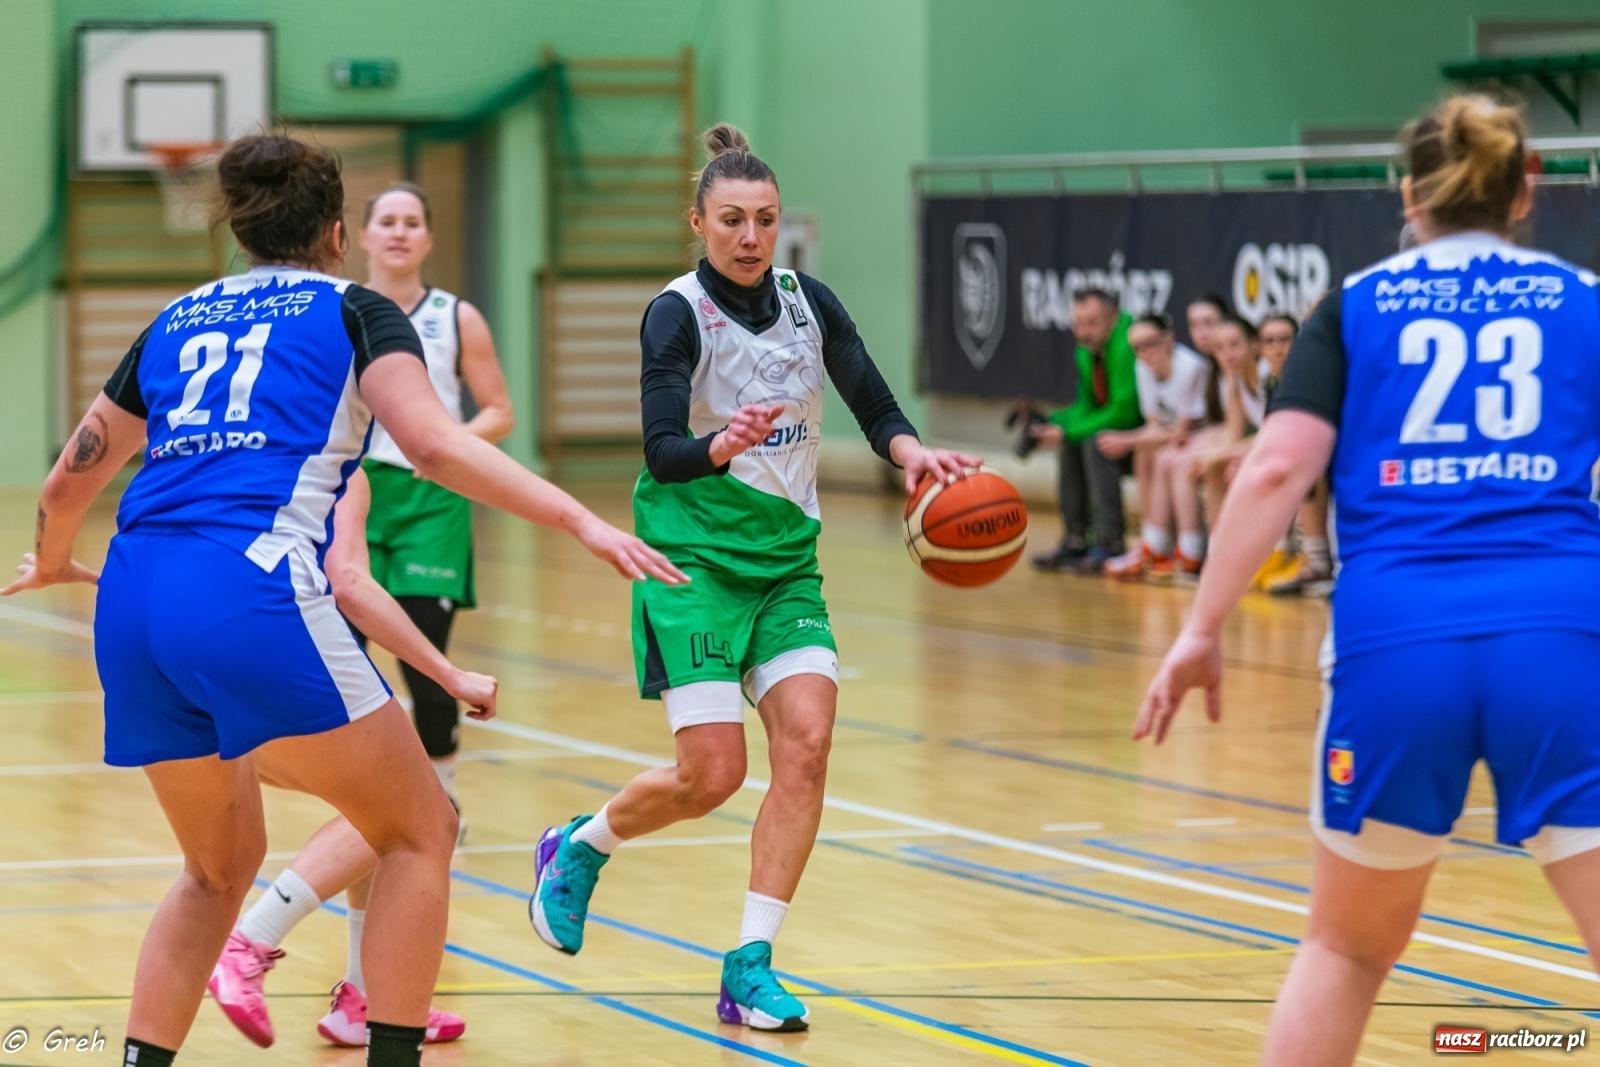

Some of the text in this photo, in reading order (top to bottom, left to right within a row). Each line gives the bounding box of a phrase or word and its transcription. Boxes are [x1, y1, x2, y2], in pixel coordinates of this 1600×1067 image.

[1375, 276, 1564, 297] MKS MOS
[166, 305, 309, 334] WROCŁAW
[170, 291, 317, 321] MKS MOS
[167, 323, 272, 431] 21
[1398, 317, 1543, 444] 23
[1410, 452, 1558, 485] BETARD
[956, 508, 1020, 537] molten
[690, 632, 734, 669] 14
